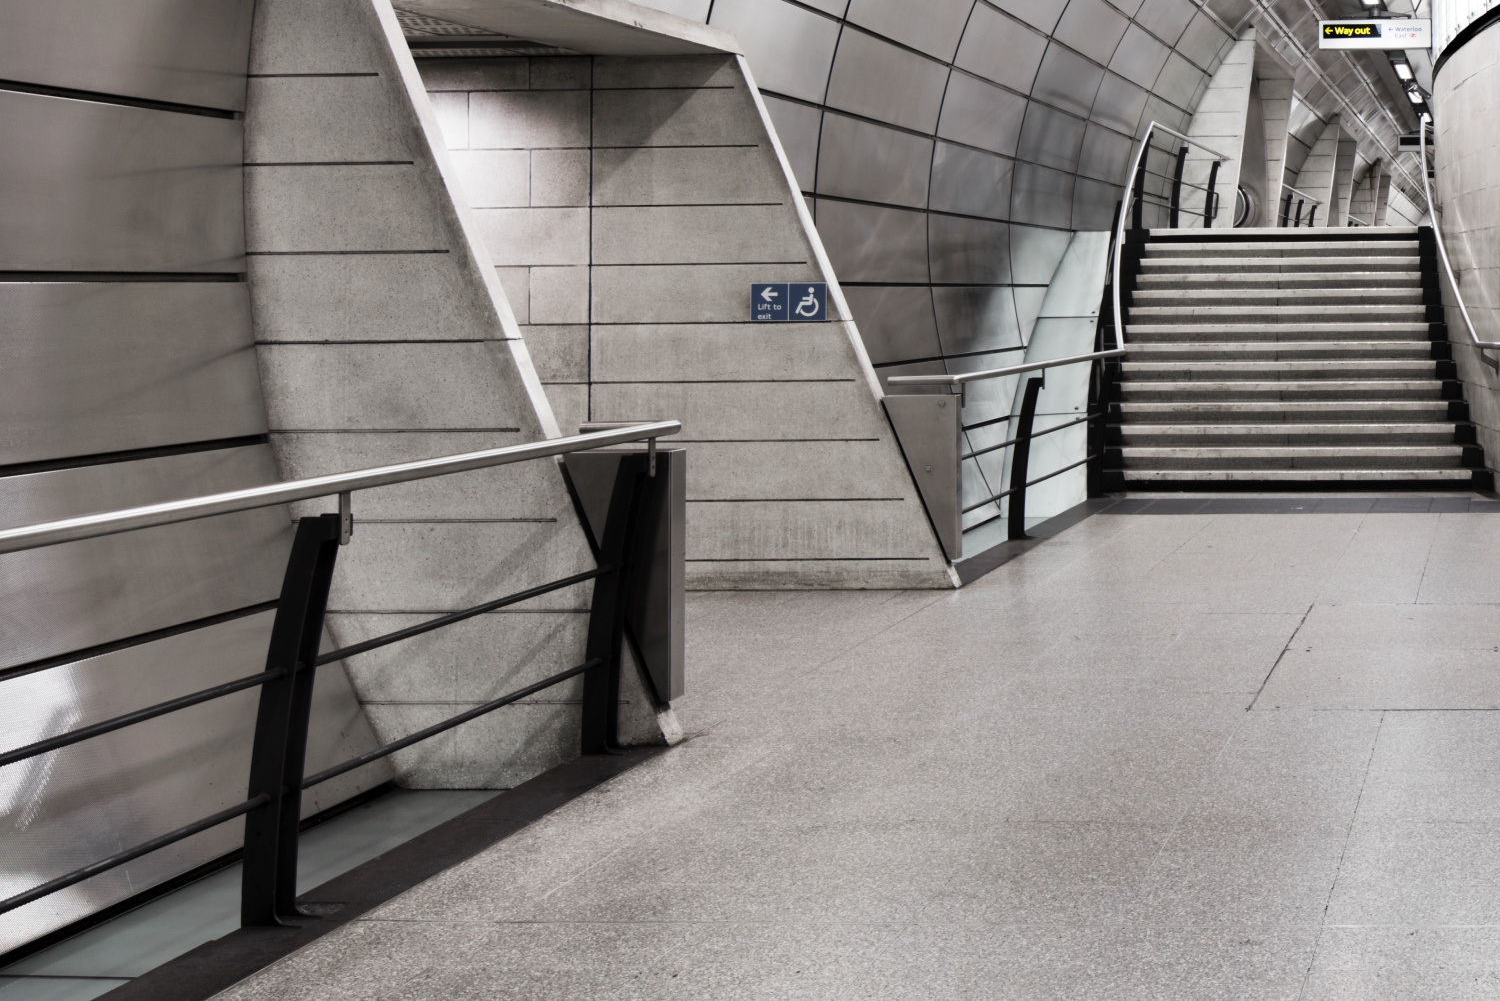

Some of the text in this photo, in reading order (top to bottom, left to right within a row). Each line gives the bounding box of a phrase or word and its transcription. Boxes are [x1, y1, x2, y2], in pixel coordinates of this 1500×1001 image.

[1335, 26, 1371, 37] Way out
[757, 303, 771, 311] Lift
